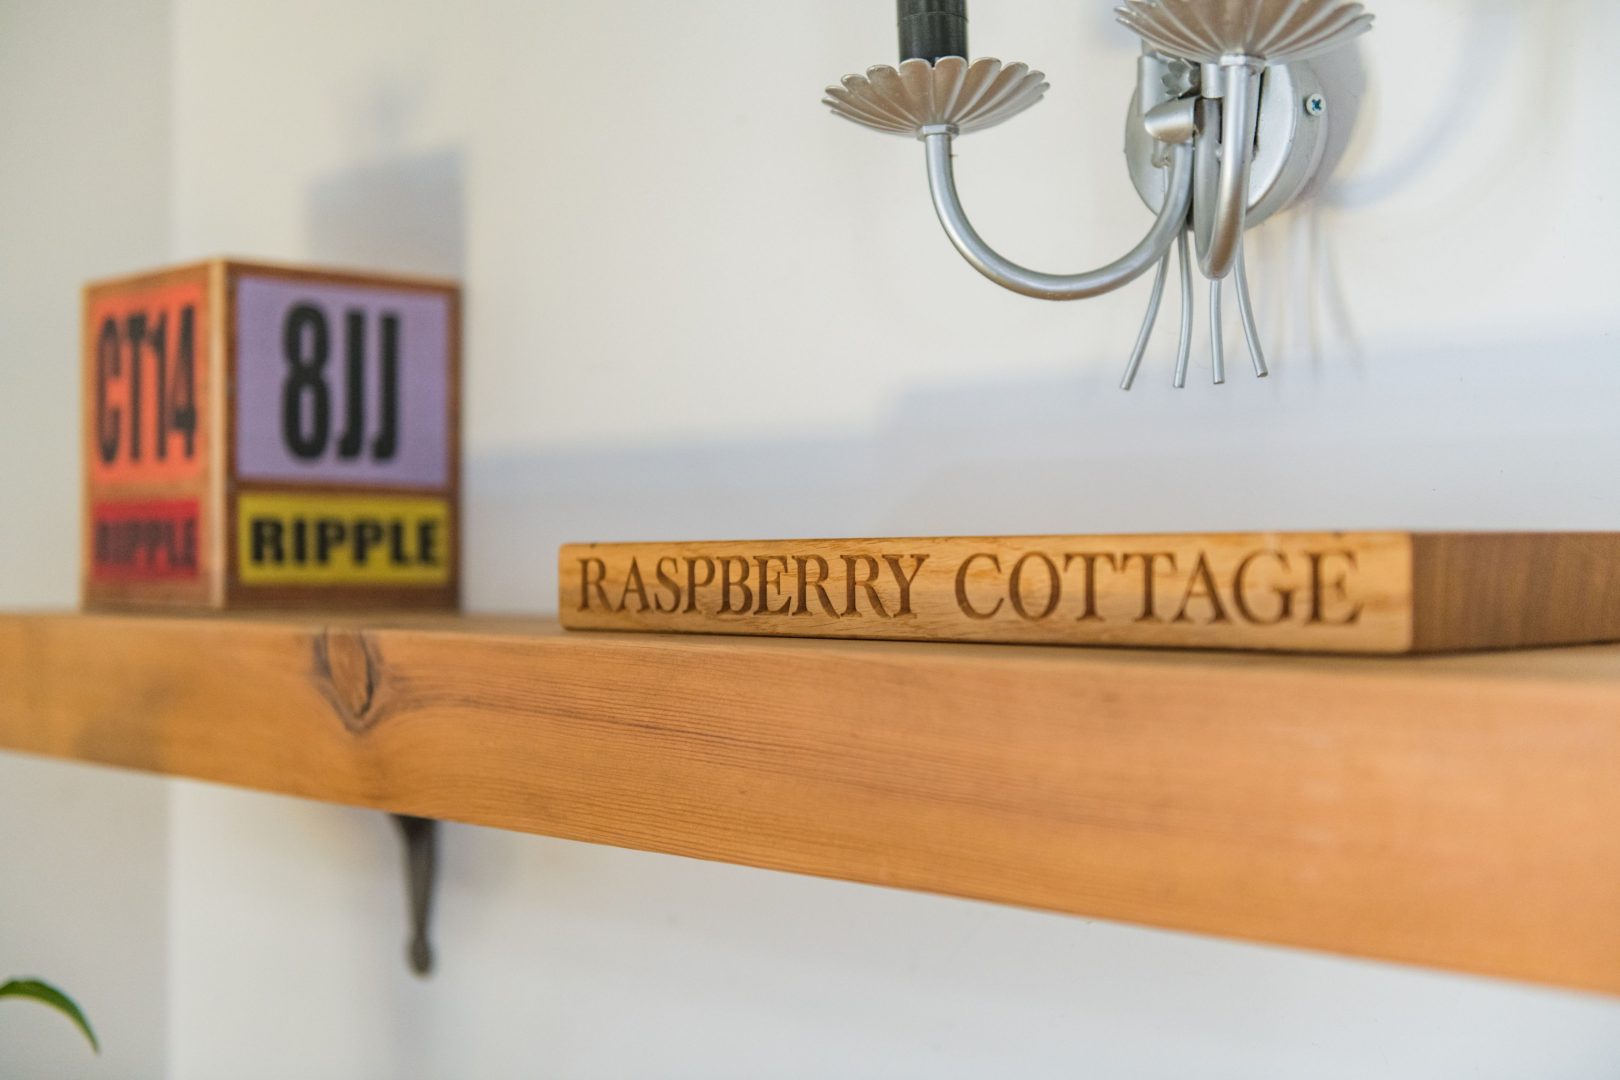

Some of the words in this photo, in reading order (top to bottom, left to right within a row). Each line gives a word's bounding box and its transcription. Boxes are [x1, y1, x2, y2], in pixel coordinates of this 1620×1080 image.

[97, 304, 197, 464] CT14
[281, 303, 401, 465] 8JJ
[250, 517, 441, 568] RIPPLE
[577, 553, 930, 619] RASPBERRY
[954, 549, 1364, 626] COTTAGE
